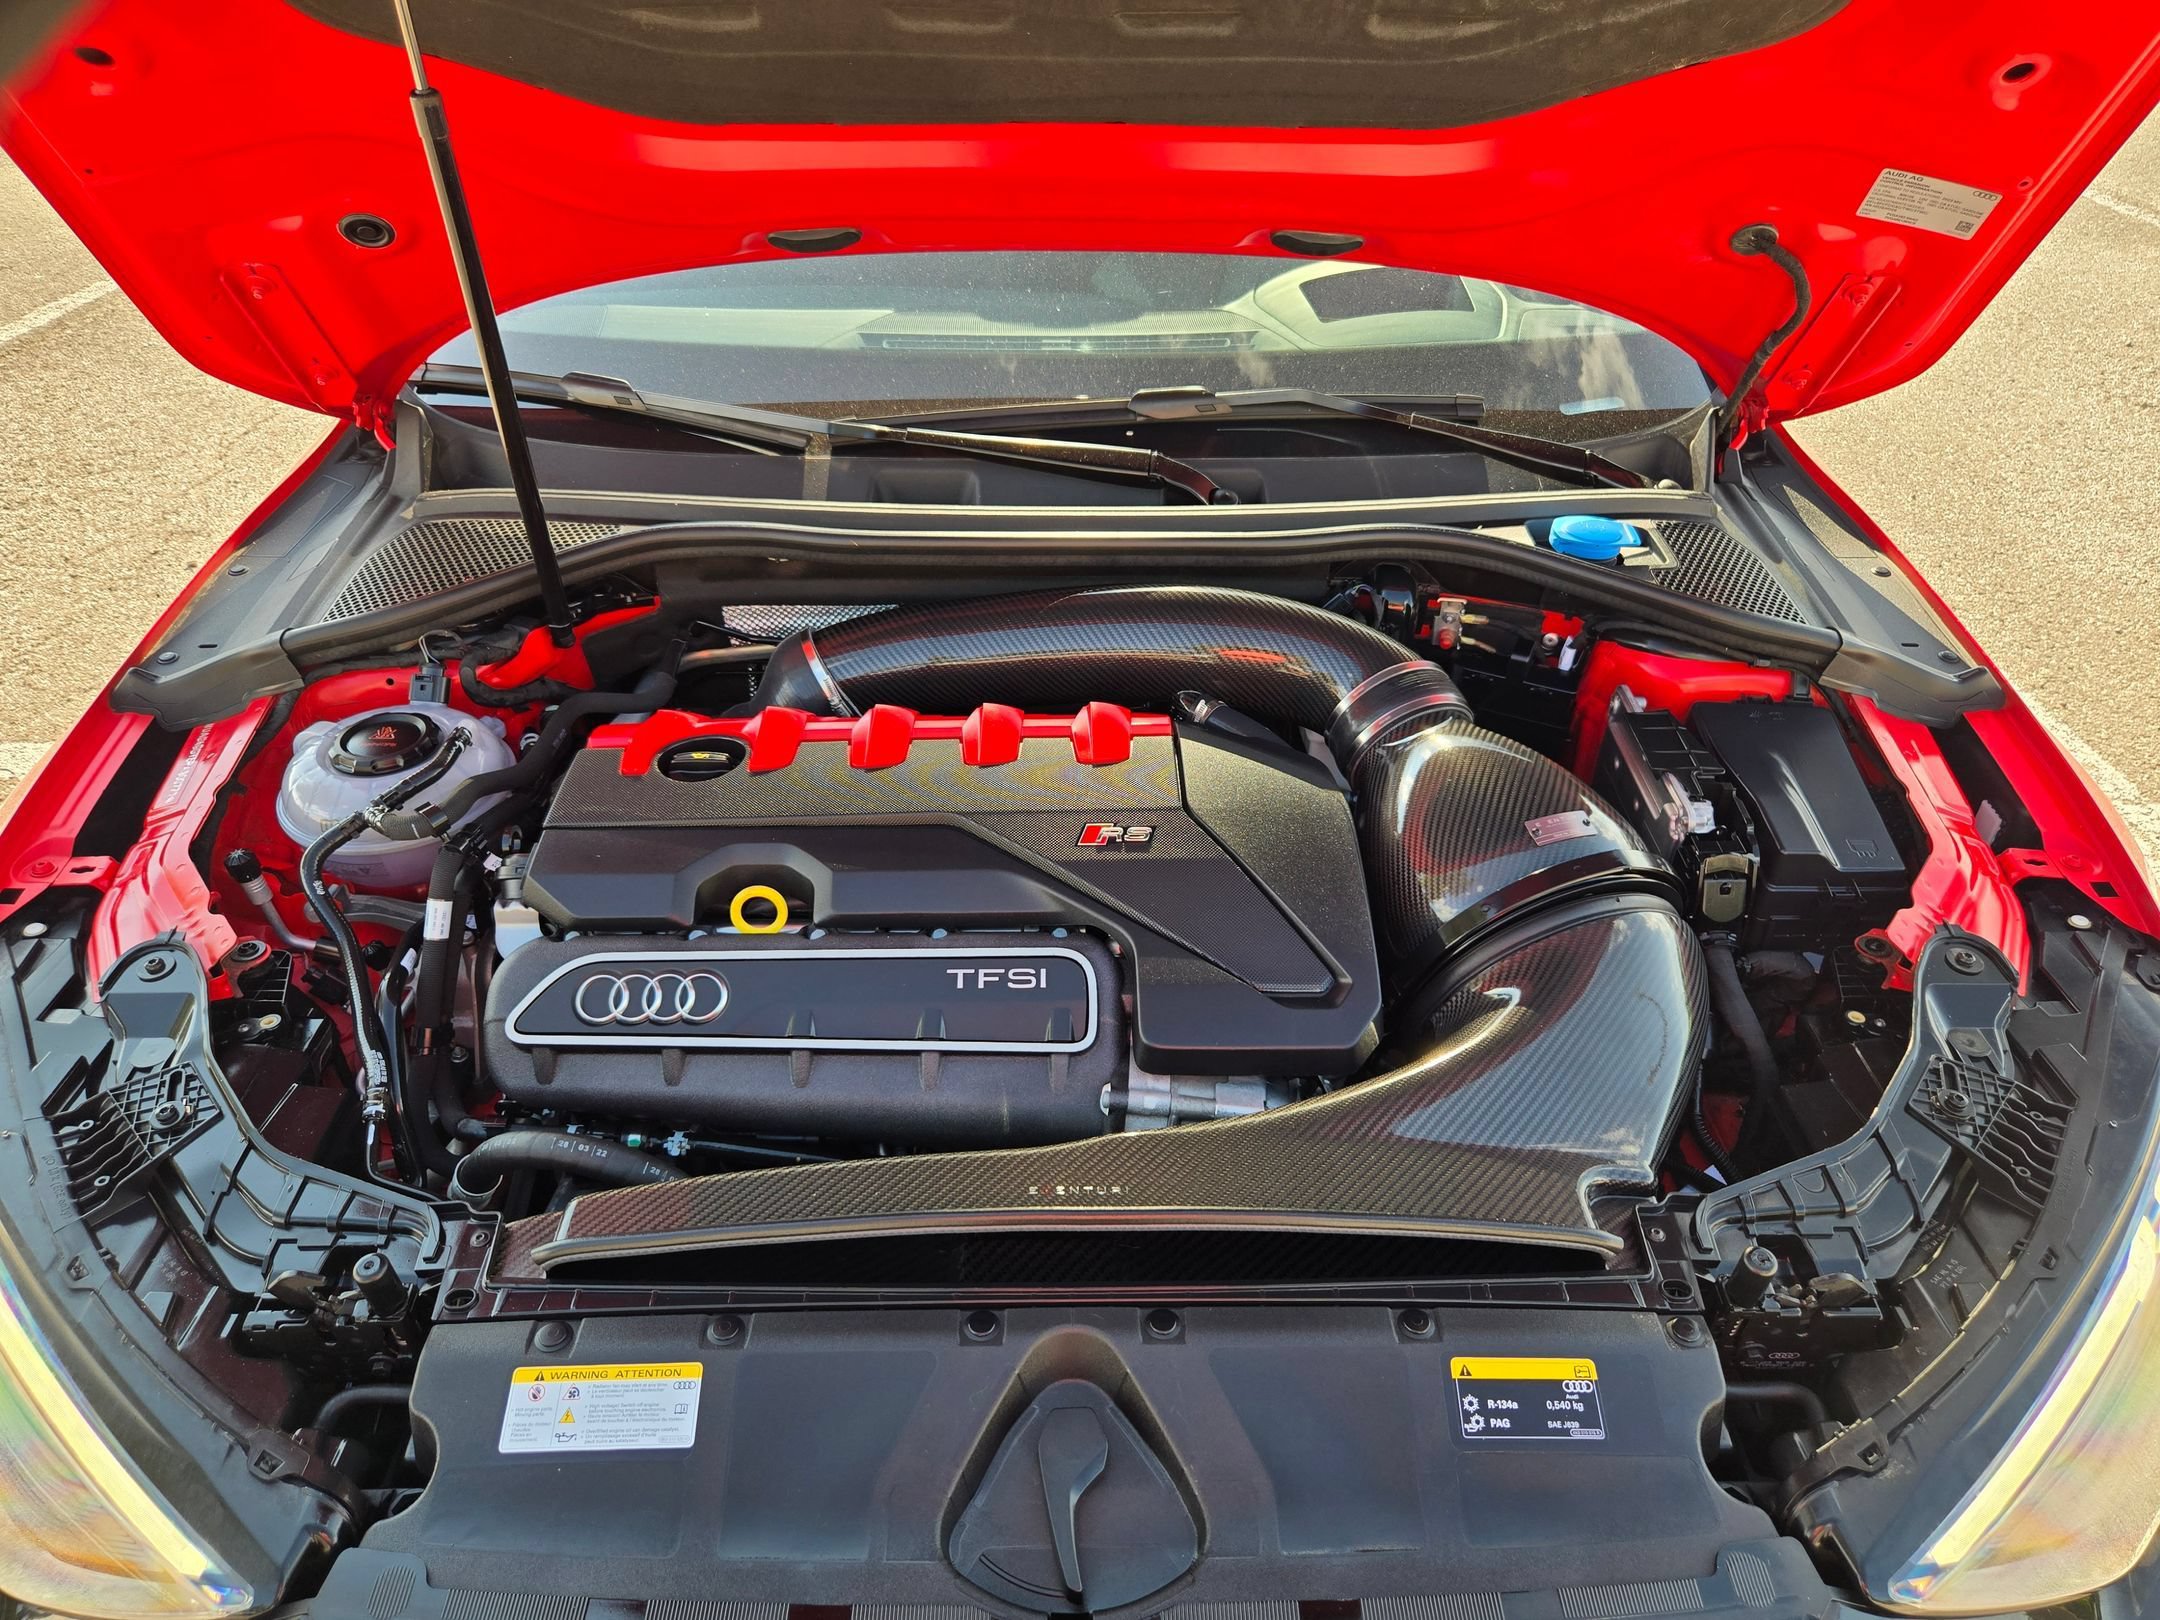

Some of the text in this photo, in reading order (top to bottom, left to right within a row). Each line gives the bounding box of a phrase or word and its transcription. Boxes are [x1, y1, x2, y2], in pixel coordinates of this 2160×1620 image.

[1884, 170, 1908, 178] AUDI
[1093, 826, 1154, 842] RS
[946, 968, 1046, 989] TFSI
[550, 1368, 682, 1380] WARNING ATTENTION
[1487, 1399, 1584, 1412] R-134a 0,540 kg
[1490, 1418, 1511, 1428] PAG
